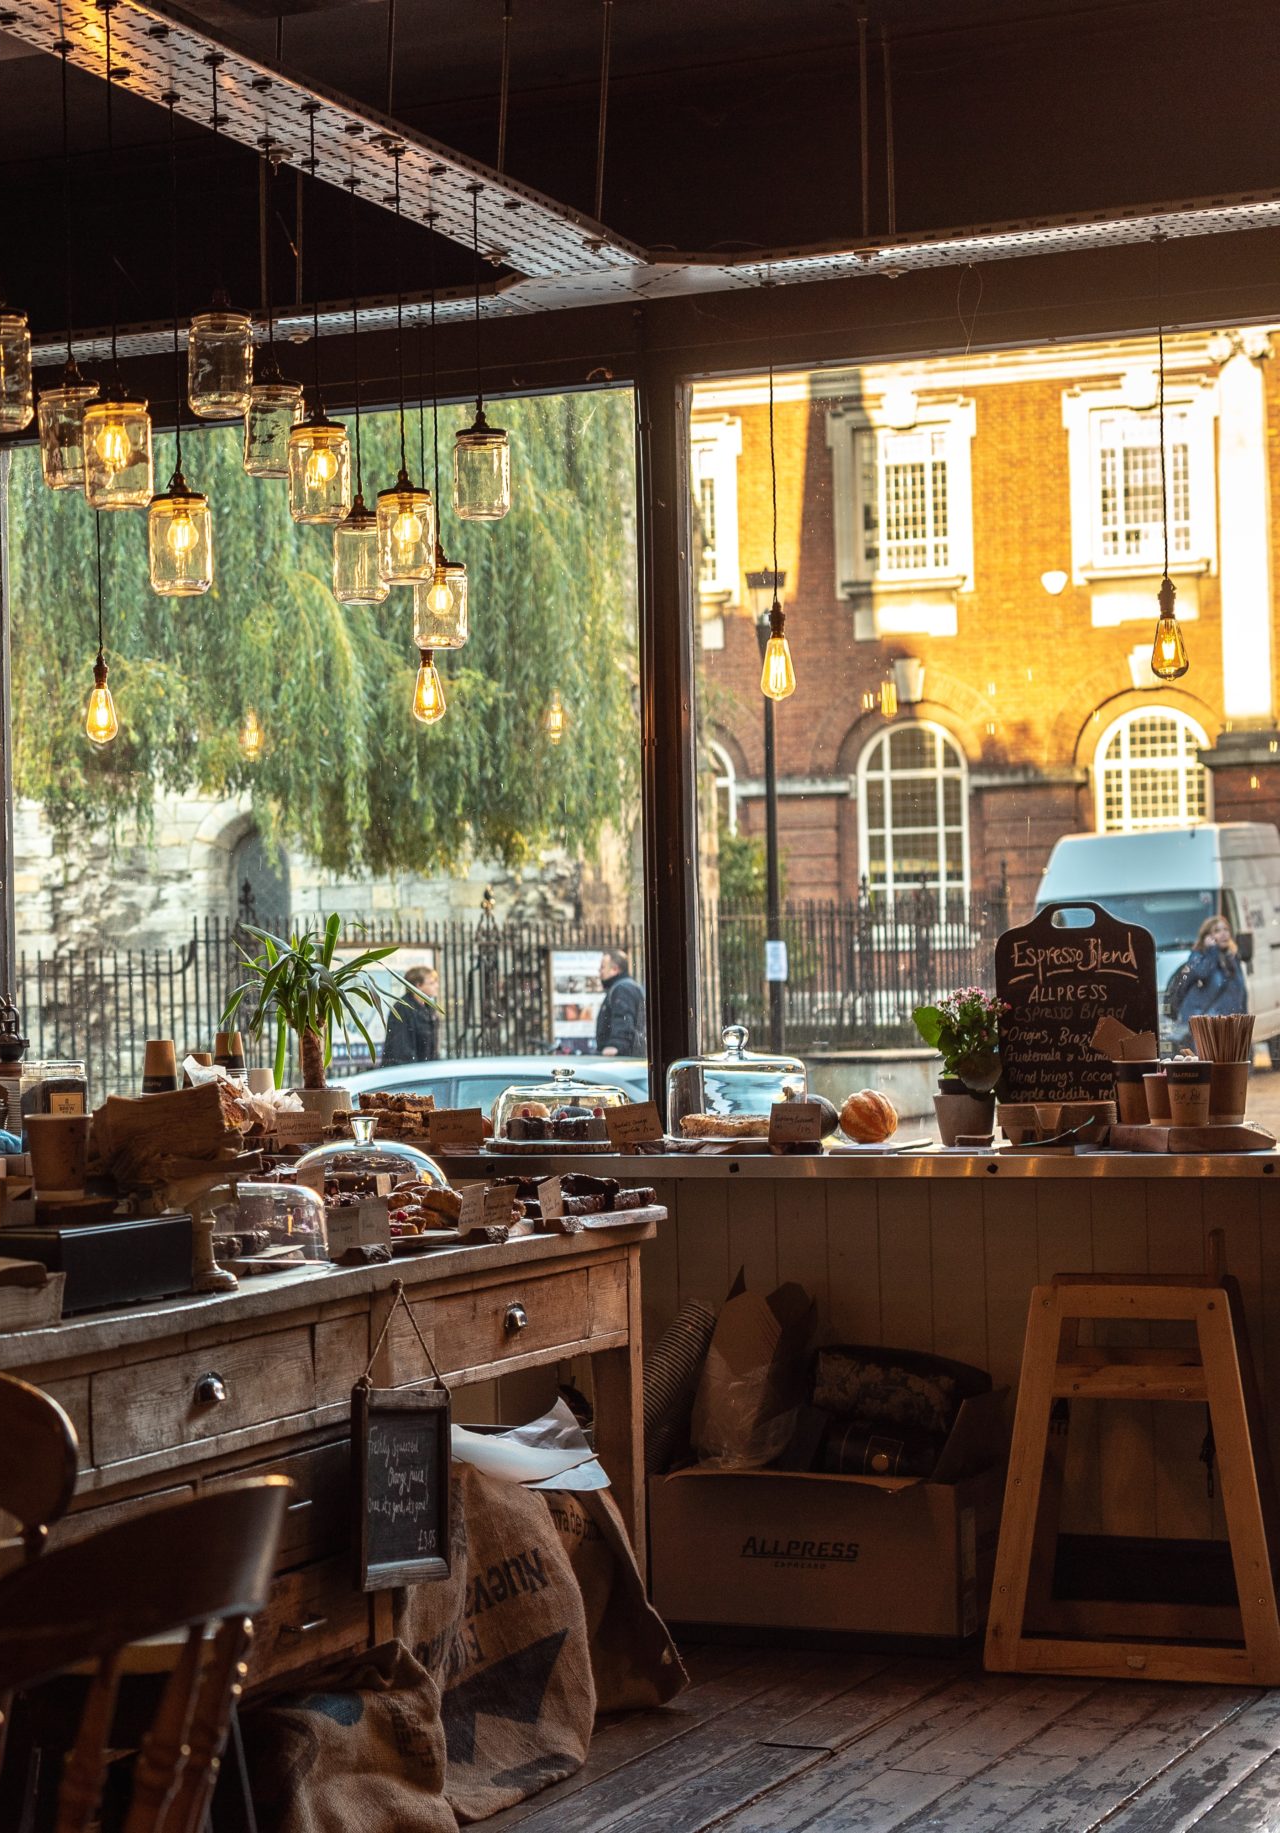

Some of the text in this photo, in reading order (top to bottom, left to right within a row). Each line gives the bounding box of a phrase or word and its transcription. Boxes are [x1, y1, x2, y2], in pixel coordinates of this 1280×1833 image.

[1010, 931, 1139, 985] Espresso Blend
[1028, 983, 1109, 1004] ALLPRESS
[1079, 1003, 1128, 1020] Blend
[1059, 1026, 1095, 1046] Brazi
[741, 1535, 859, 1559] ALLPRESS
